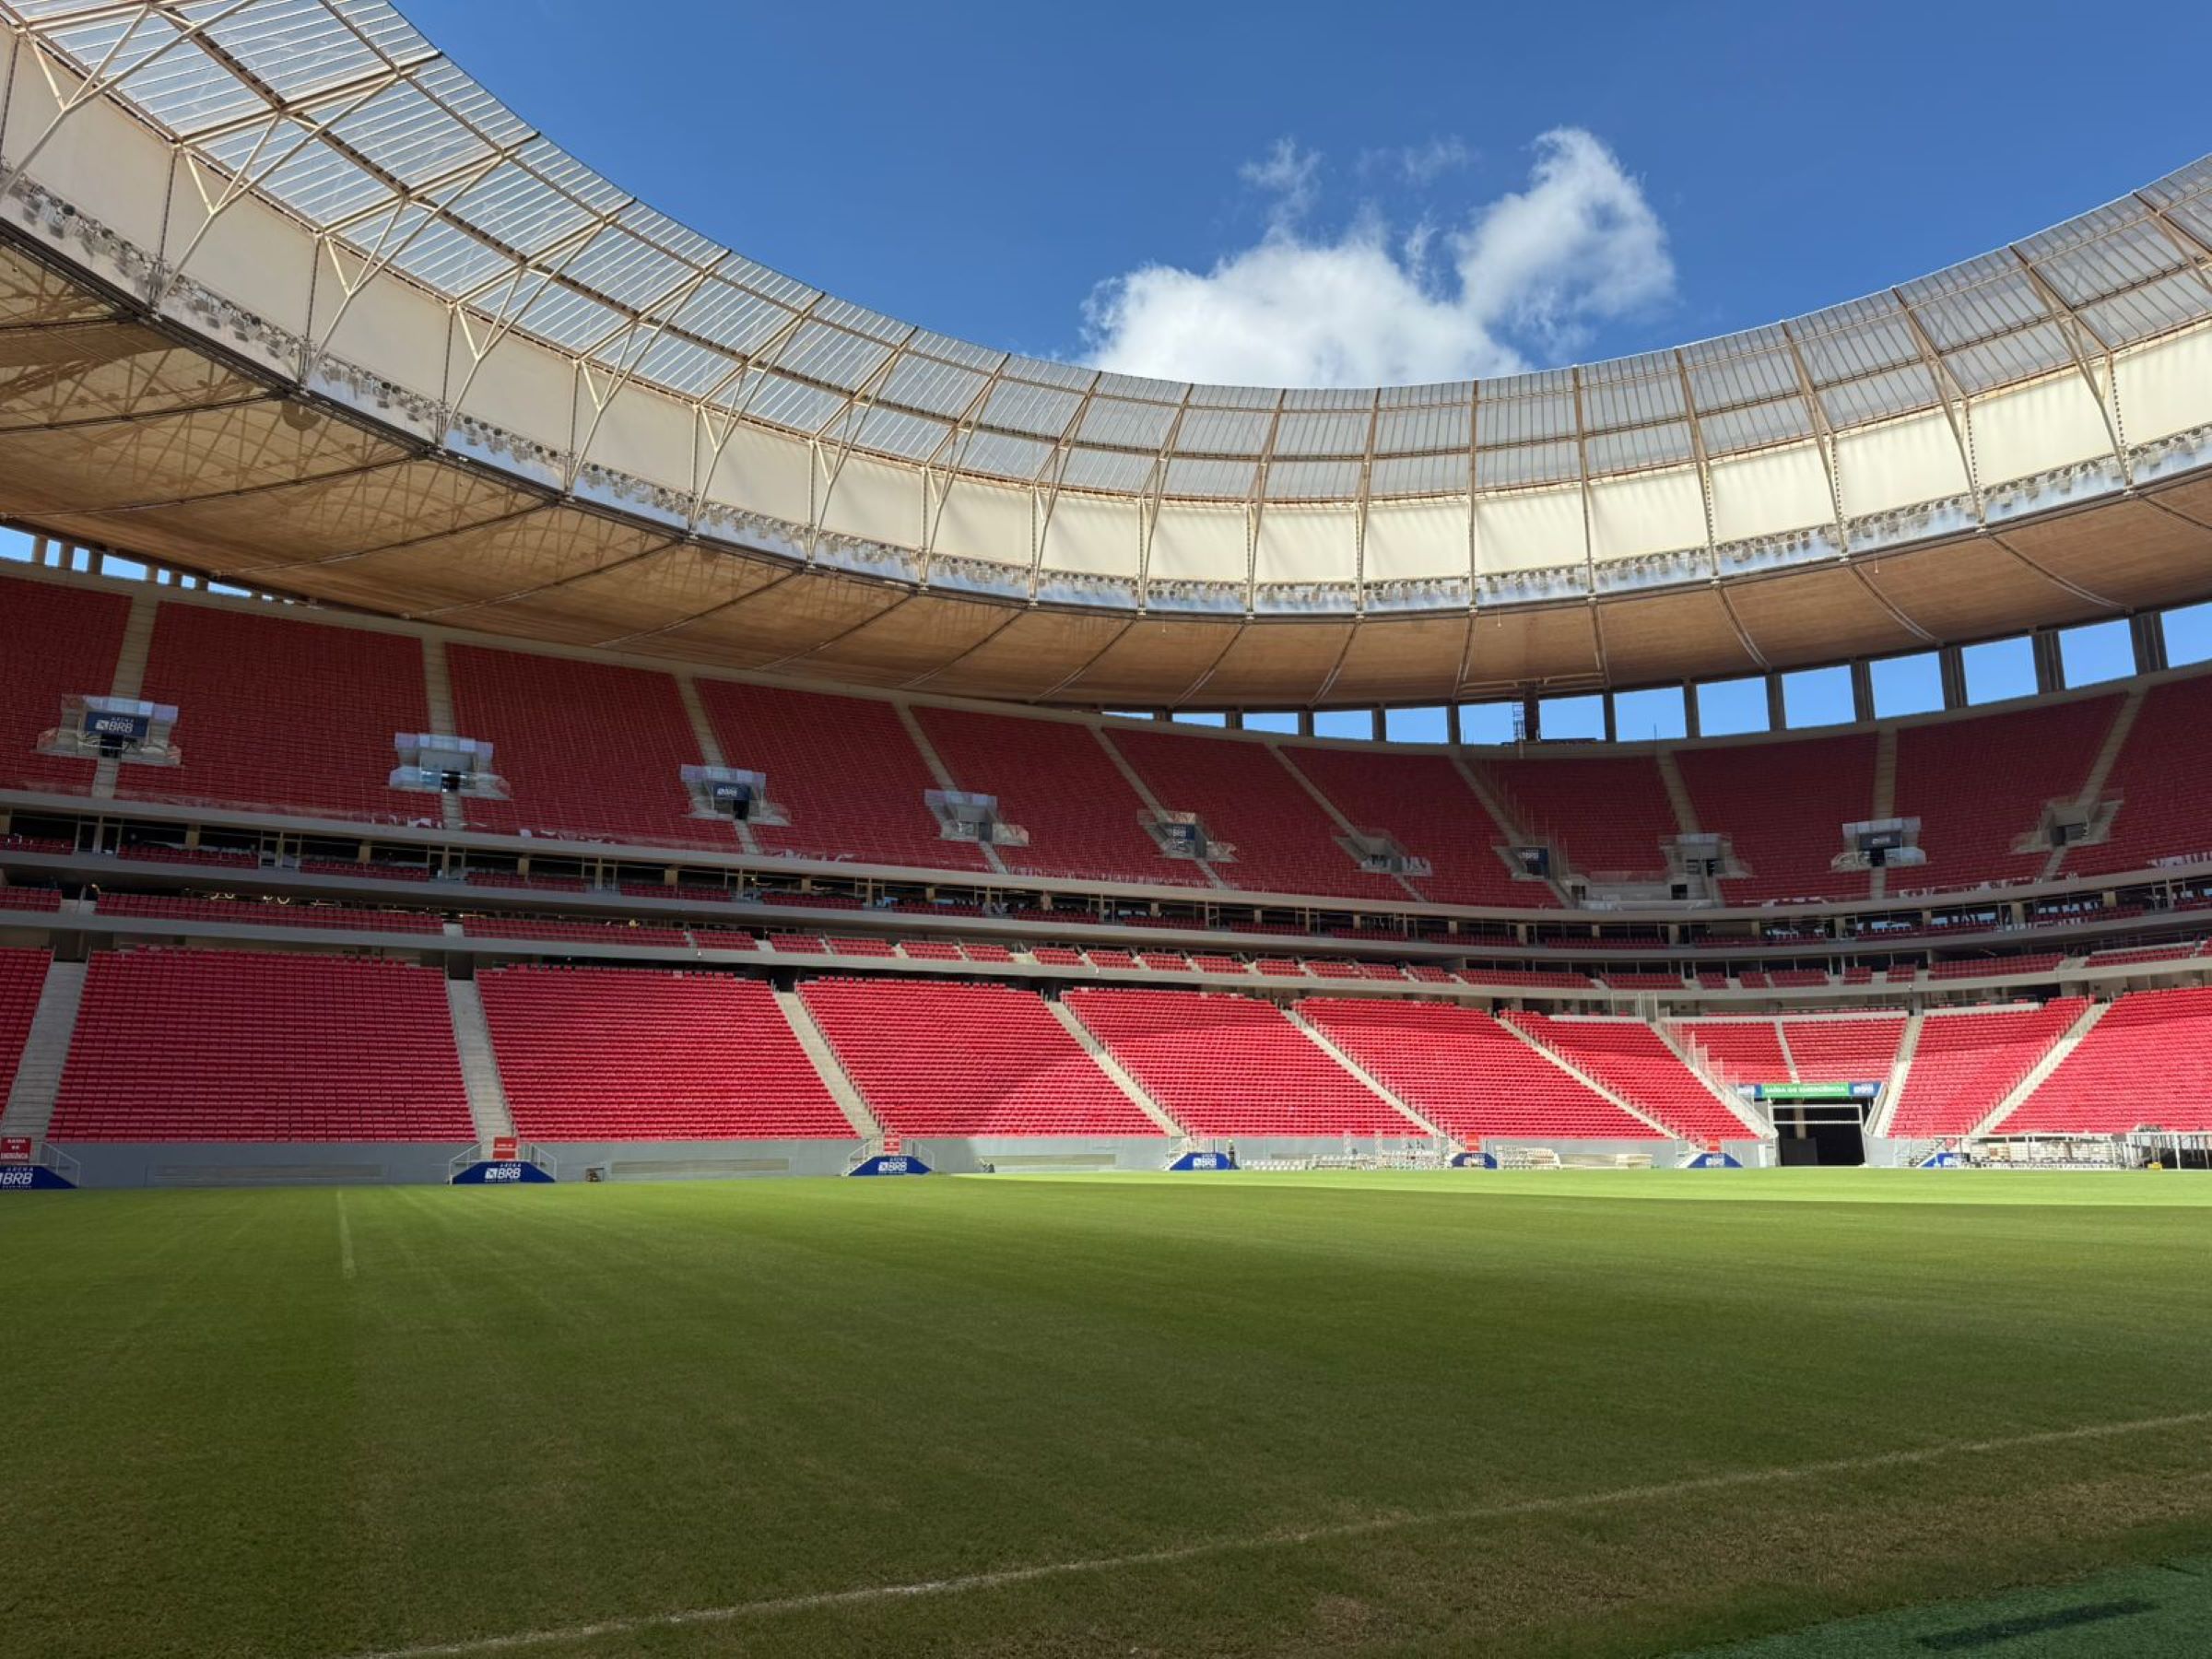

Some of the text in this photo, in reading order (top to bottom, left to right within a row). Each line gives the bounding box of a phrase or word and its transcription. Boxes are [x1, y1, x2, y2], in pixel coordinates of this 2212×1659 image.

[109, 721, 134, 734] BRB
[888, 1161, 908, 1171] BRB
[2, 1171, 33, 1185] BRB
[497, 1168, 522, 1180] BRB
